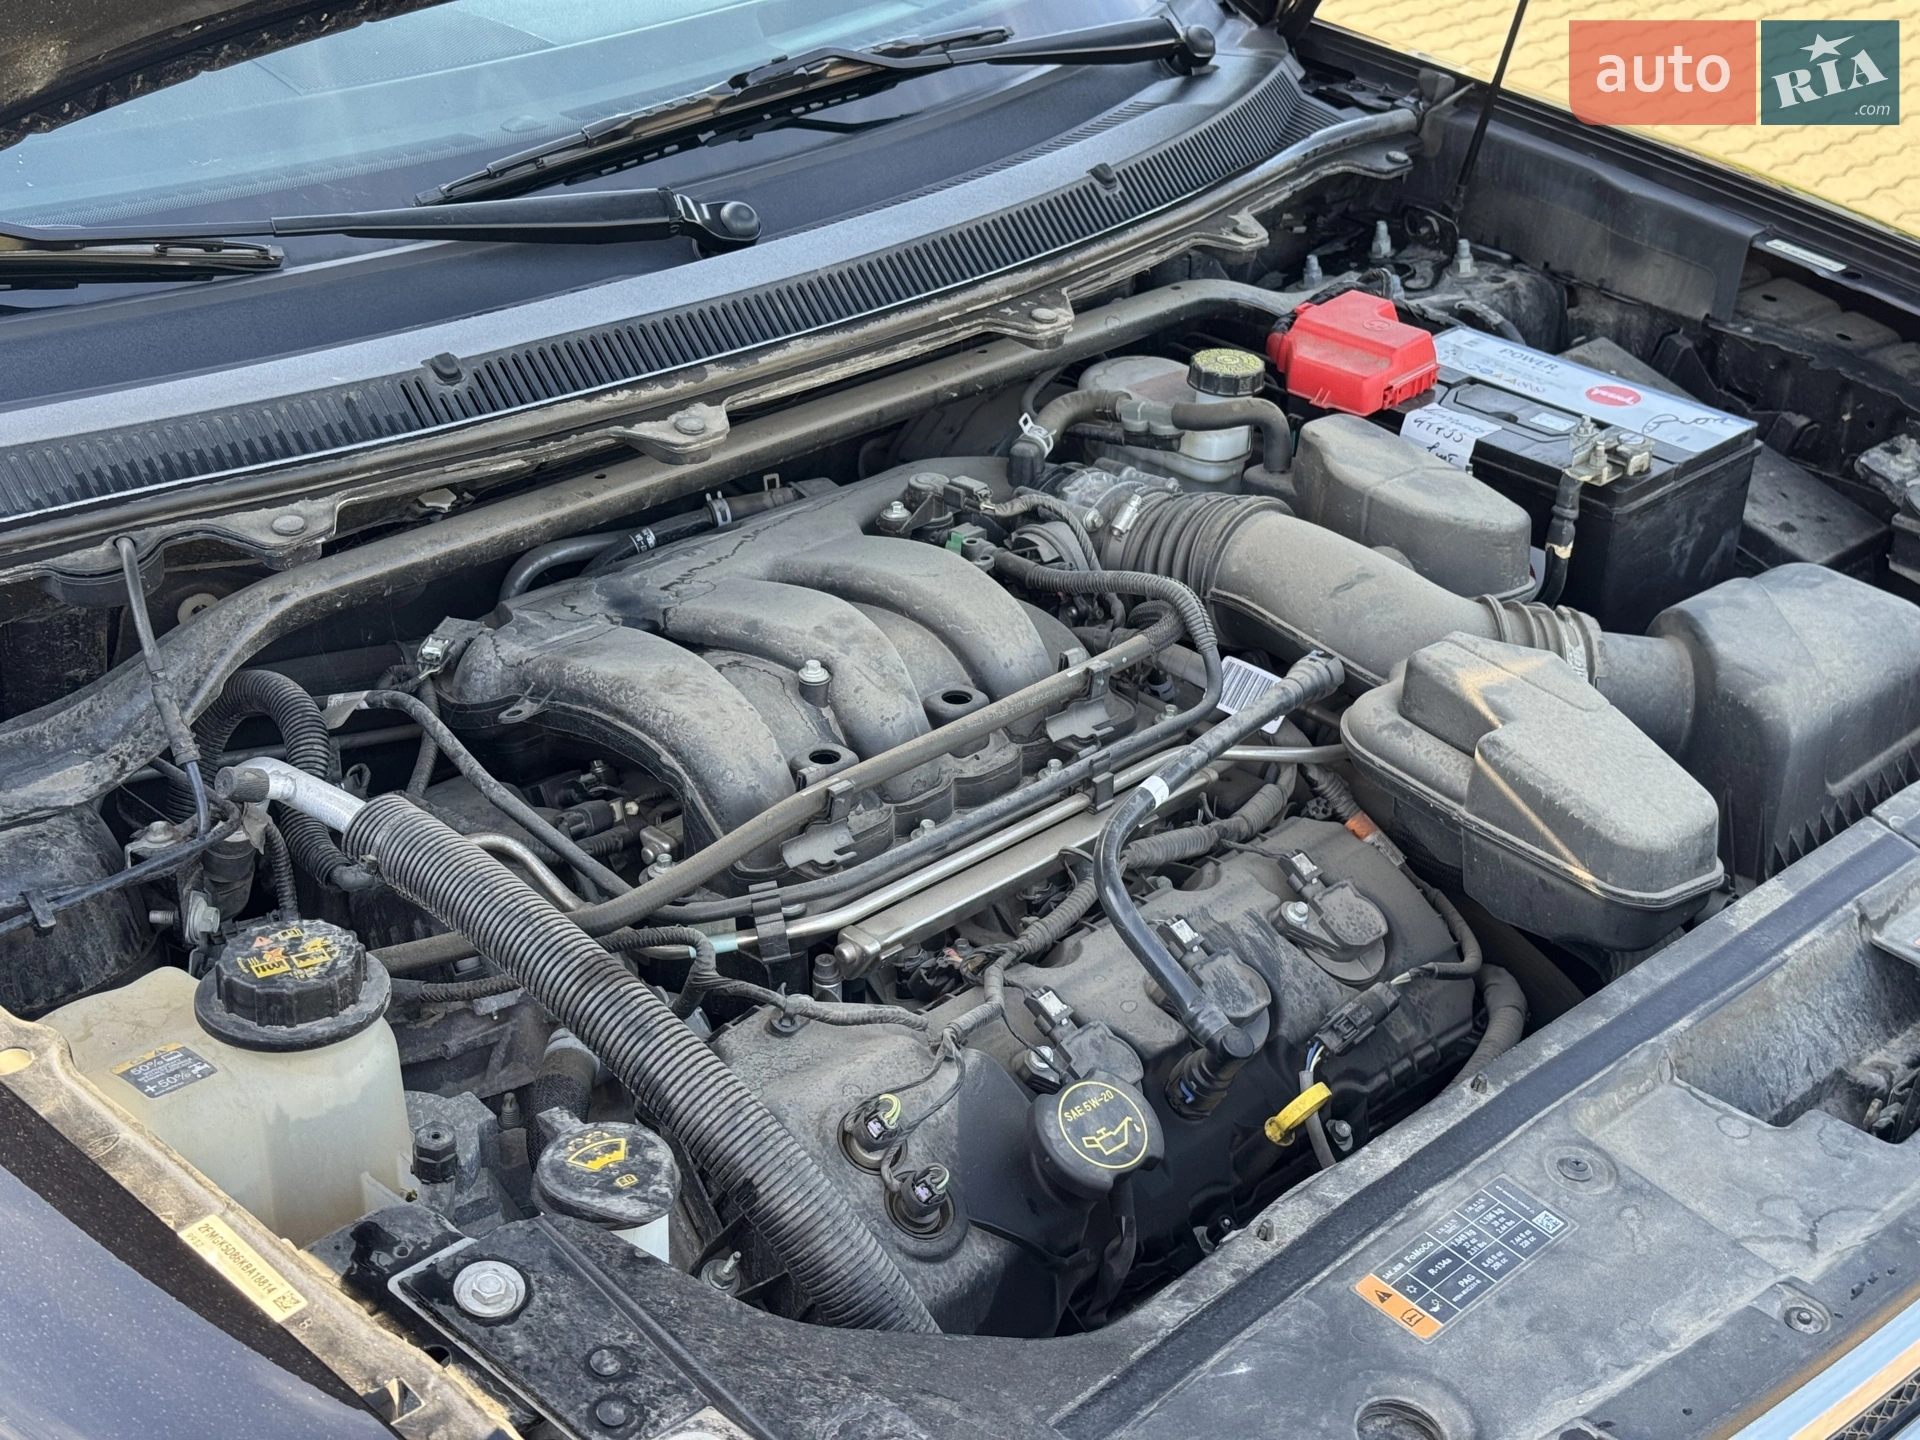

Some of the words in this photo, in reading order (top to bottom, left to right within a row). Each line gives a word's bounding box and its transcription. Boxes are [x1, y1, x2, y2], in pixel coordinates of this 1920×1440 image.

[1499, 348, 1560, 372] POWER
[130, 1059, 164, 1075] 50%
[157, 1072, 191, 1087] 50%
[1064, 1105, 1085, 1122] SAE
[1082, 1089, 1114, 1111] 5W-20
[1403, 1241, 1434, 1263] FoMoCo
[1462, 1241, 1471, 1249] 37
[1467, 1245, 1480, 1256] 2.31
[198, 1223, 277, 1295] 2FMGK5D86KBA18814
[1427, 1257, 1453, 1276] R-134a
[1457, 1273, 1476, 1288] PAG
